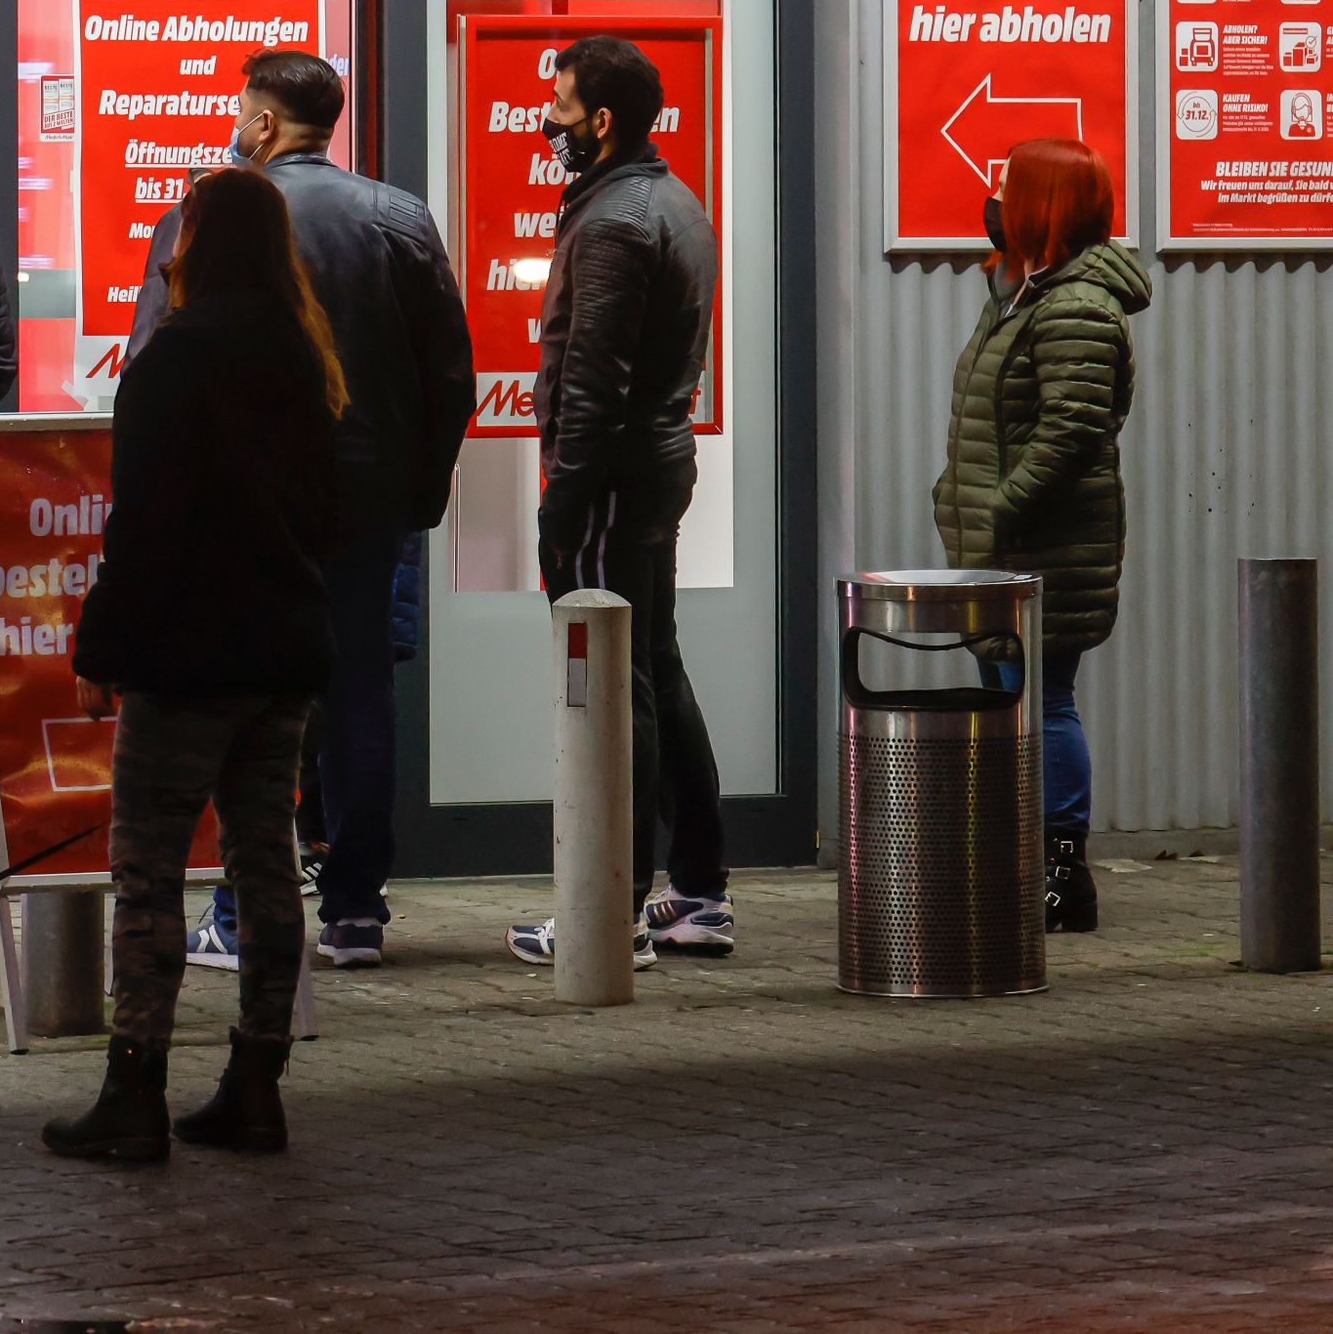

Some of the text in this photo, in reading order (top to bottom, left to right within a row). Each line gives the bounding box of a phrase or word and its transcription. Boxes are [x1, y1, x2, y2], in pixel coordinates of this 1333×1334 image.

[84, 15, 309, 47] Online Abholungen
[909, 6, 1111, 43] hier abholen
[1223, 25, 1257, 34] ABHOLEN?
[1223, 36, 1268, 45] ABER SICHER!
[180, 55, 217, 75] und
[1223, 94, 1250, 103] KAUFEN
[1185, 110, 1209, 120] 31.12.
[1215, 161, 1268, 177] BLEIBEN
[1269, 162, 1289, 177] SIE
[135, 177, 162, 199] bis
[1201, 180, 1328, 192] Wir freuen uns darauf, Sie bald
[1231, 193, 1257, 203] Markt
[1258, 193, 1297, 205] begrüßen
[1299, 194, 1309, 203] zu
[30, 494, 113, 537] Onli
